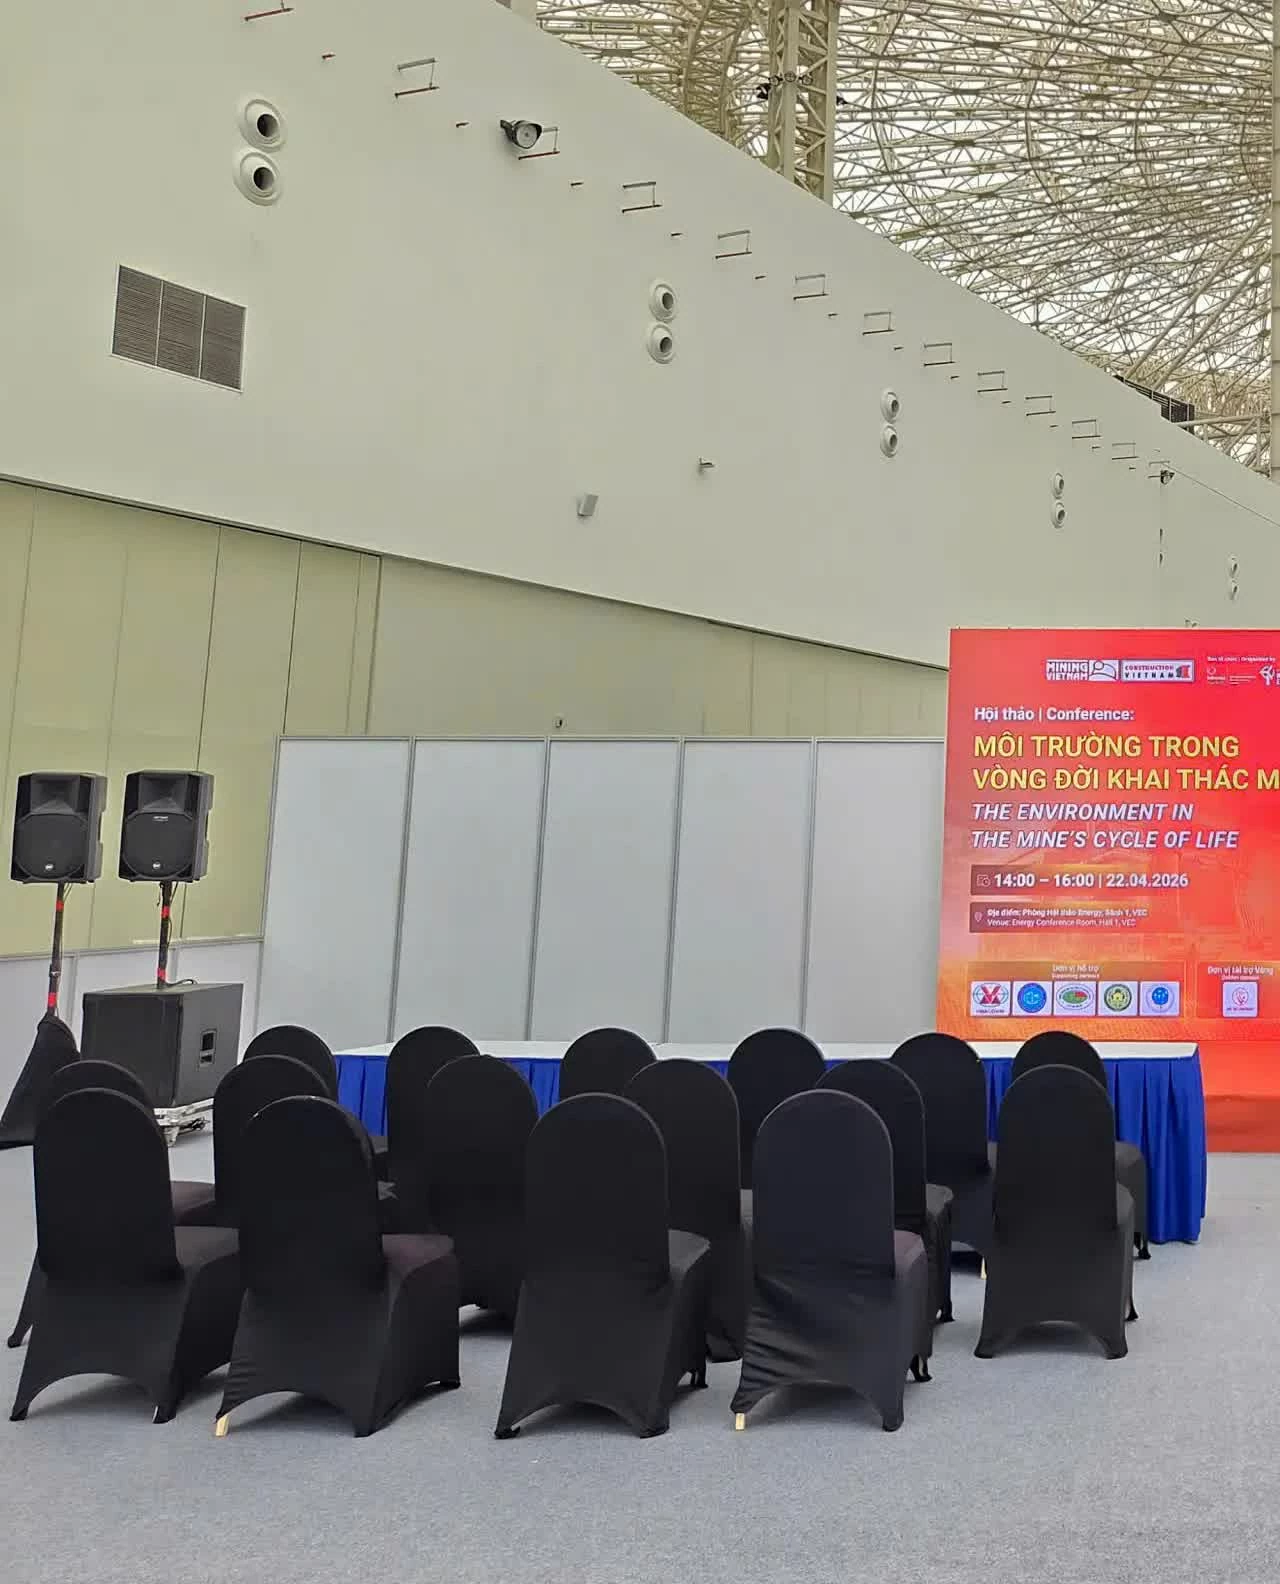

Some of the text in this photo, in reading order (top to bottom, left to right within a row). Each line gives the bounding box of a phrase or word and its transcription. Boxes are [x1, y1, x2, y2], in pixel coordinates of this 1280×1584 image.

[1047, 661, 1088, 673] MINING
[1046, 672, 1088, 681] VIETNAM
[974, 706, 998, 723] Hội
[1002, 706, 1034, 721] thảo
[1046, 706, 1135, 721] Conference:
[974, 730, 1240, 758] MÔI TRƯỜNG TRONG
[973, 764, 1047, 790] VÒNG
[1054, 764, 1099, 790] ĐỜI
[1107, 768, 1170, 790] KHAI
[1176, 764, 1249, 790] THÁC
[972, 803, 1194, 821] THE ENVIRONMENT IN
[971, 831, 1011, 848] THE
[1093, 831, 1159, 849] CYCLE
[1163, 831, 1190, 849] OF
[1195, 831, 1239, 849] LIFE
[994, 873, 1035, 888] 14:00
[1053, 873, 1094, 888] 16:00
[1106, 873, 1189, 888] 22.04.2026
